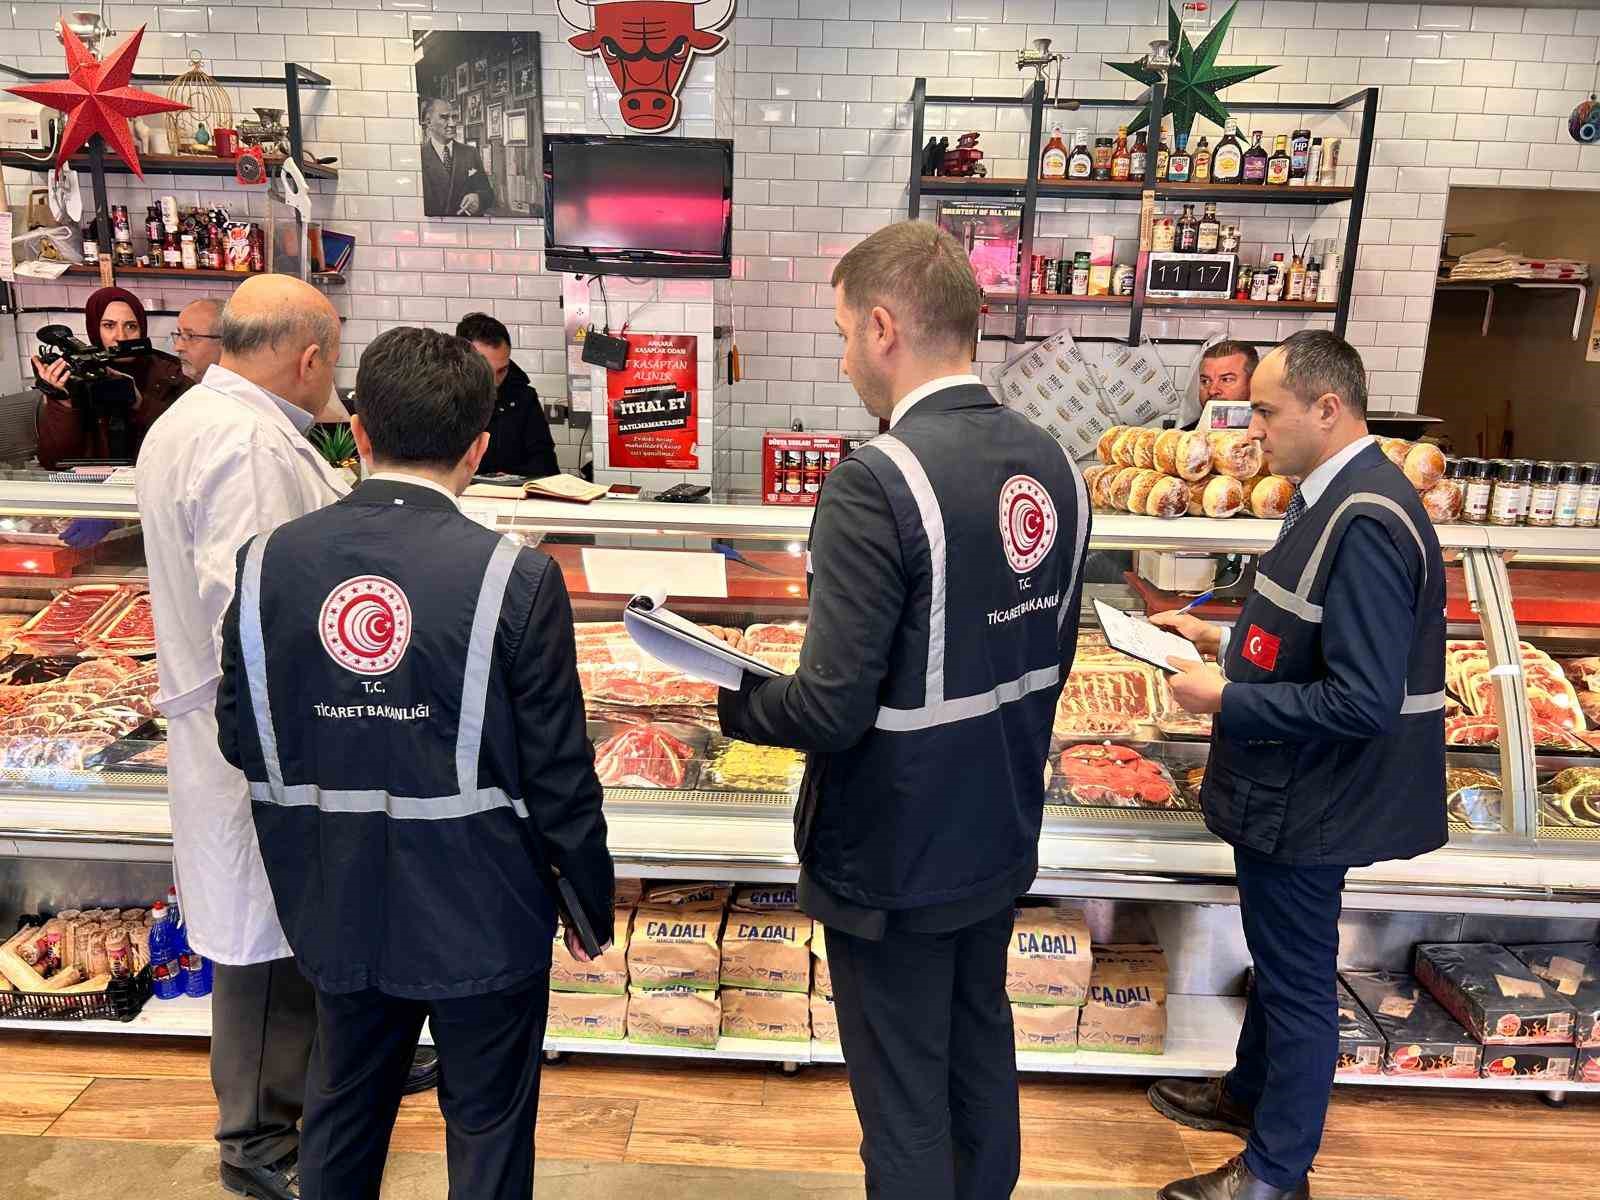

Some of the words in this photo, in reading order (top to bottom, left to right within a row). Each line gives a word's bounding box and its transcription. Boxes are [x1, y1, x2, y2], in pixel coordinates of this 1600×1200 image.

[1294, 142, 1308, 151] HP
[1158, 265, 1182, 284] 11
[1197, 265, 1222, 283] 17
[632, 359, 688, 369] KASAPTAN
[620, 400, 665, 415] İTHAL
[667, 396, 687, 411] ET
[361, 681, 386, 694] T.C.
[314, 702, 364, 718] TİCARET
[367, 703, 430, 721] BAKANLIĞI
